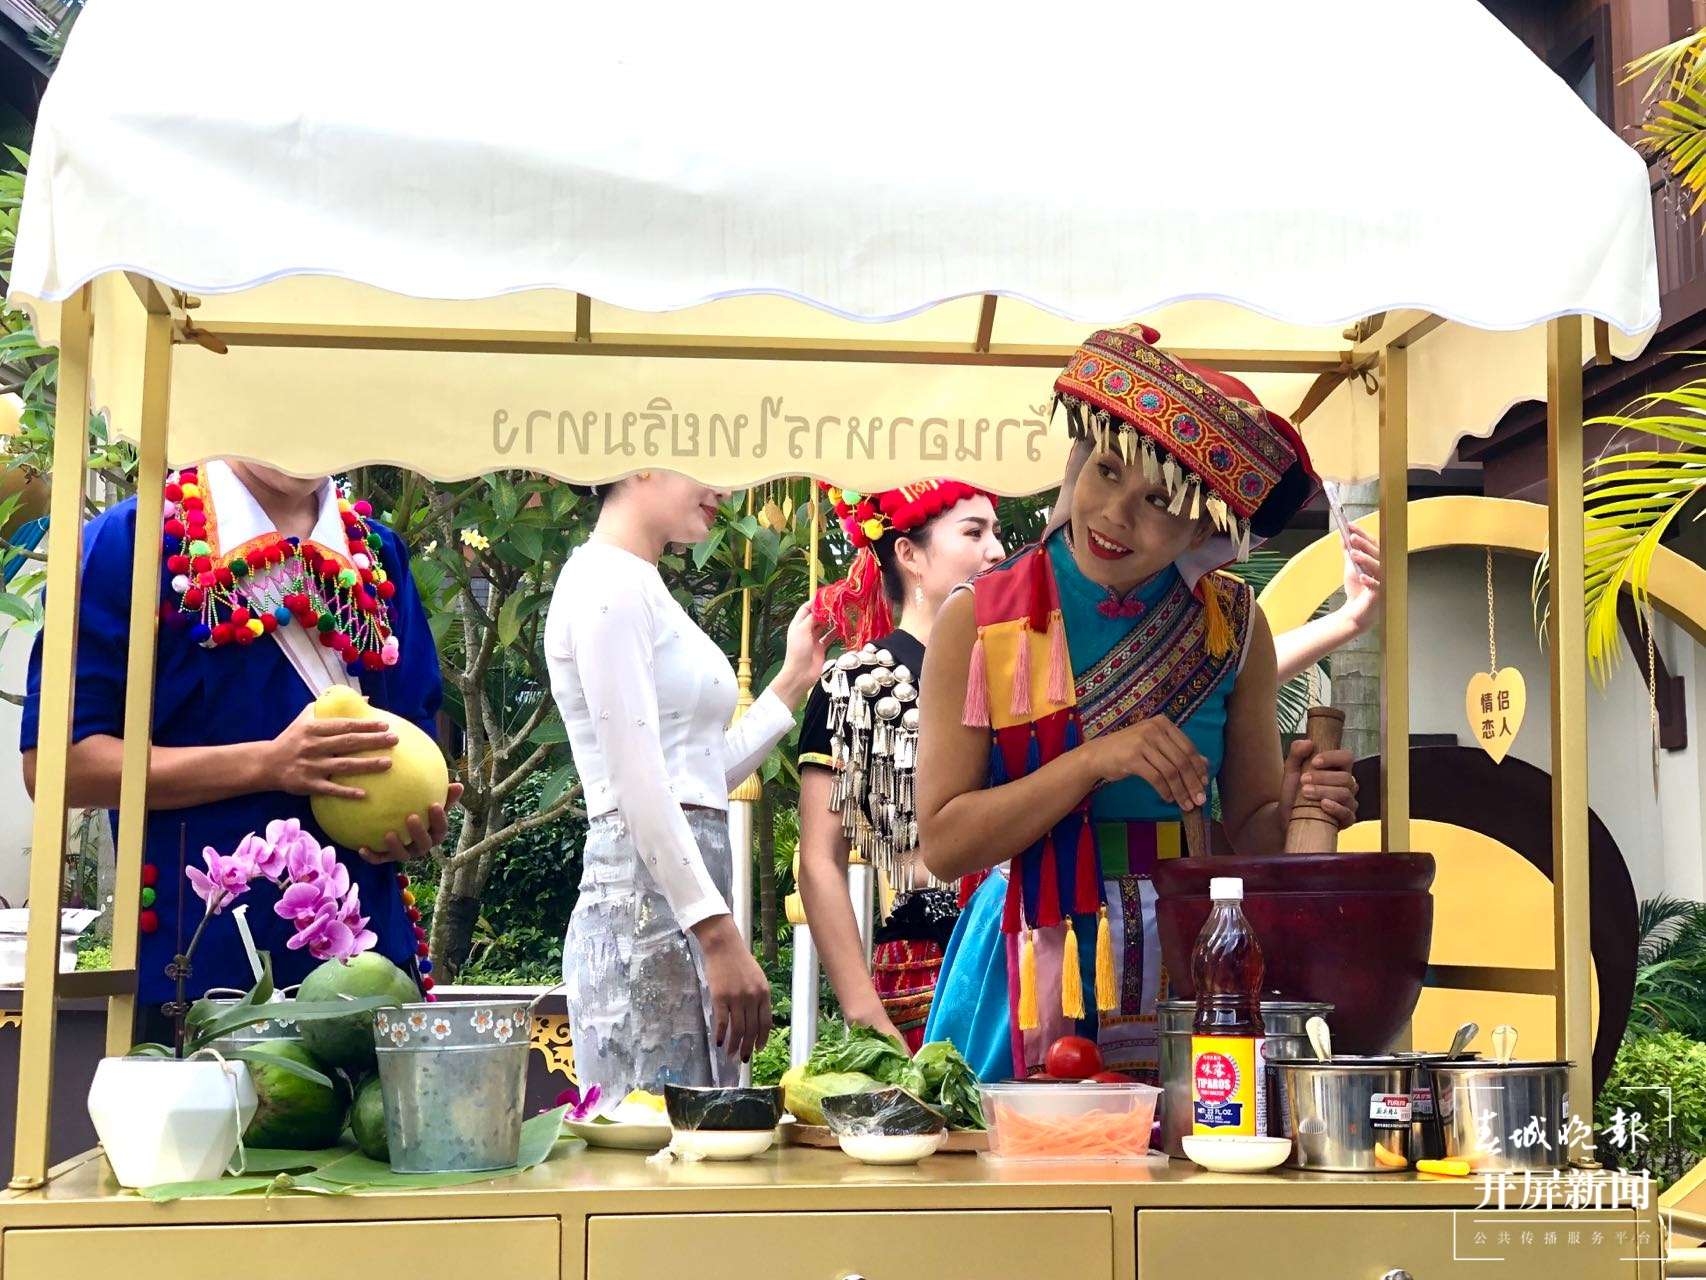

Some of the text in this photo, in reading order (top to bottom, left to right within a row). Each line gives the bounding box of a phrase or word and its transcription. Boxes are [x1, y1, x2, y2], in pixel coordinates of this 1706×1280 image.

[1481, 690, 1510, 713] 情侣
[1482, 716, 1512, 740] 恋人
[1197, 1078, 1231, 1090] TIPAROS
